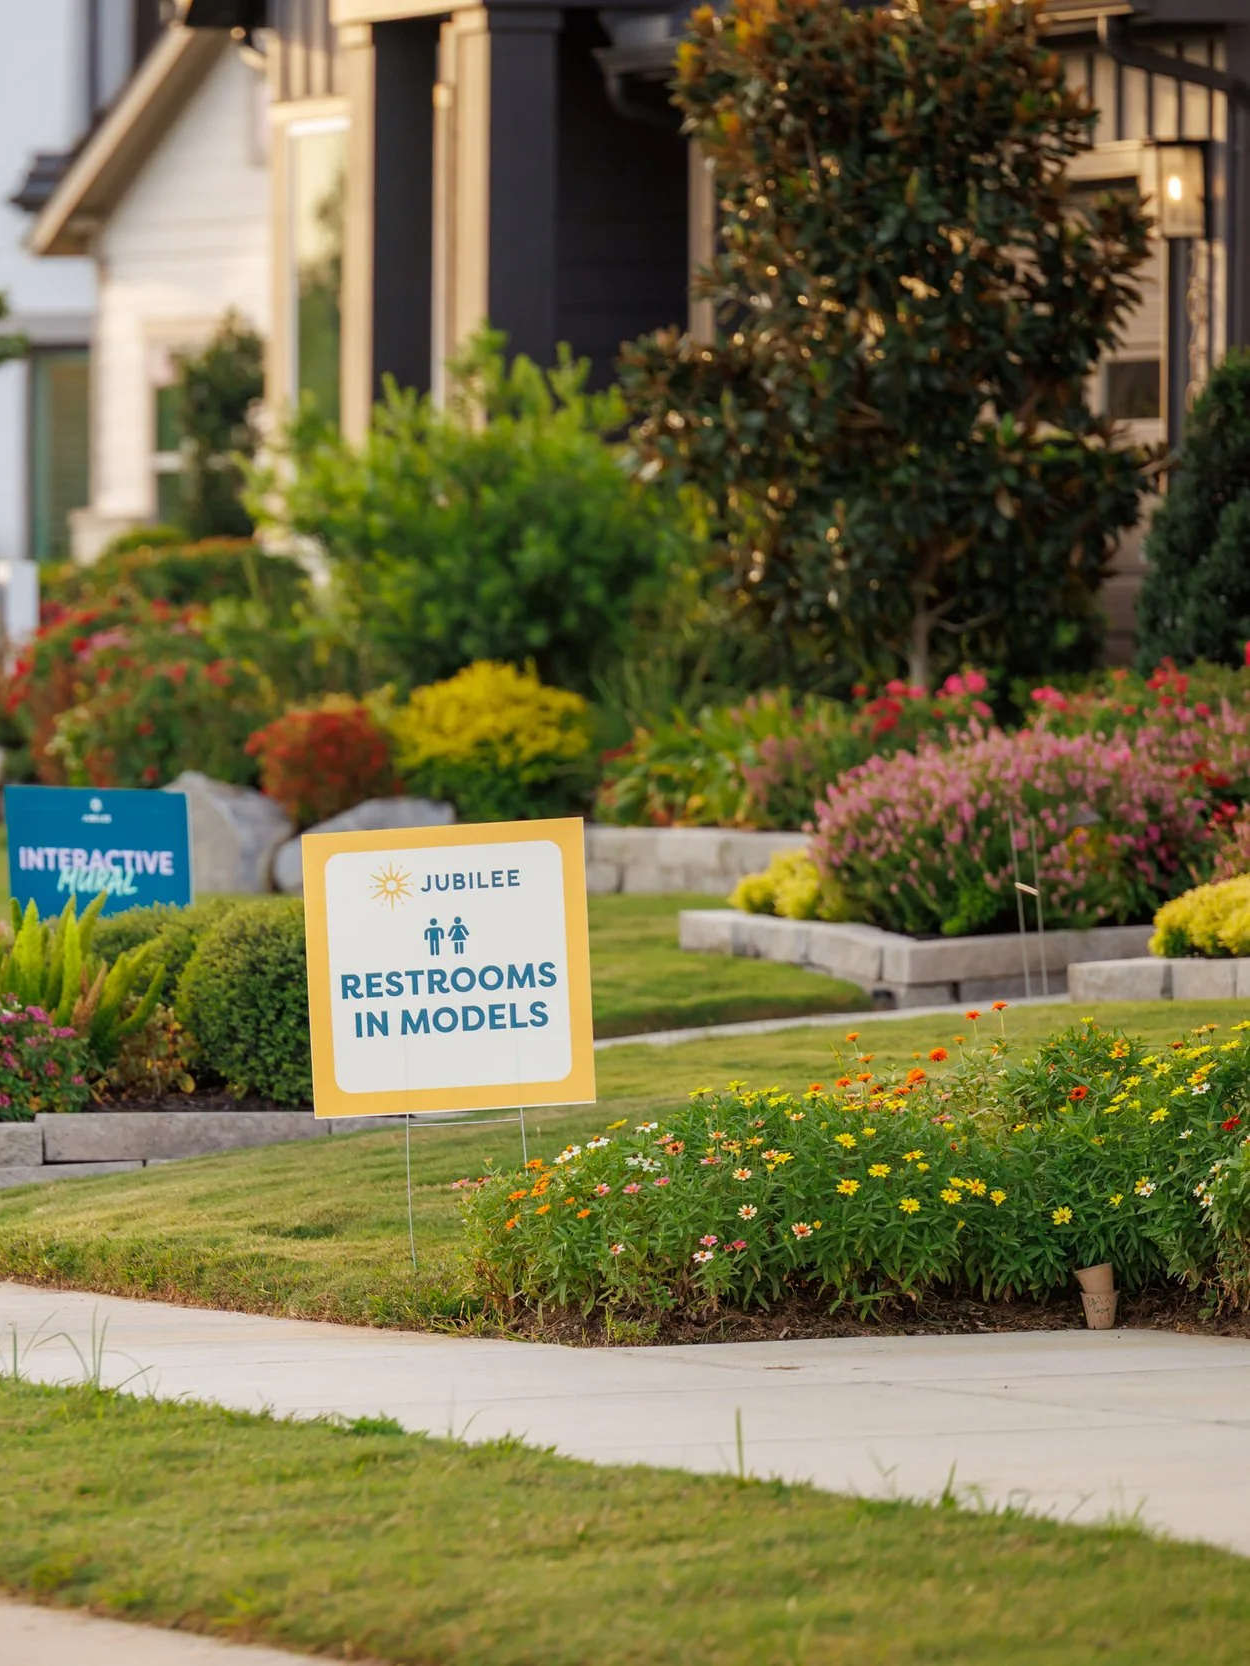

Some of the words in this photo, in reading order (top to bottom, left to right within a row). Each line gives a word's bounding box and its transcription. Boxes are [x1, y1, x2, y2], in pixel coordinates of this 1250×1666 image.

[19, 847, 174, 875] INTERACTIVE
[420, 868, 521, 893] JUBILEE
[341, 961, 557, 1000] RESTROOMS
[354, 1010, 389, 1038] IN
[400, 1001, 549, 1036] MODELS
